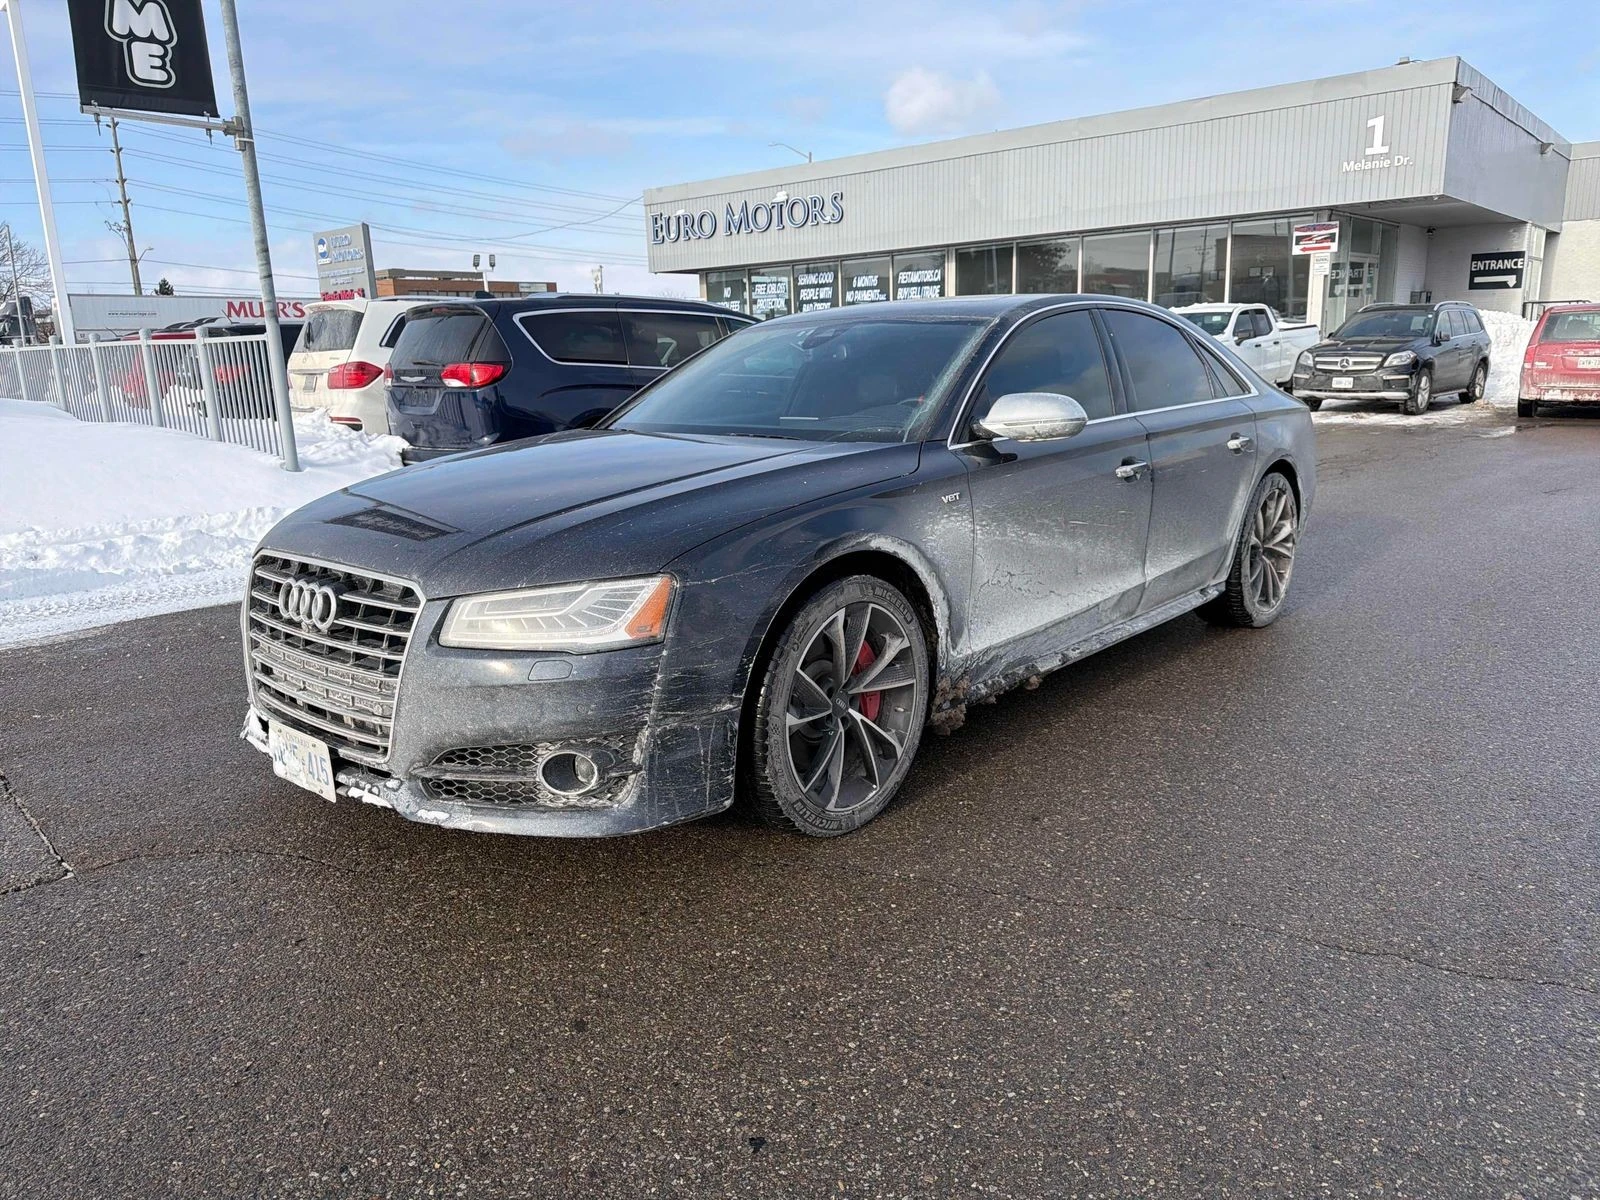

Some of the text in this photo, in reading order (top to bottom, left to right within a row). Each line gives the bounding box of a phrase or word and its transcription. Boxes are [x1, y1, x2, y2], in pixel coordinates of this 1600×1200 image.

[1364, 114, 1389, 155] 1
[1342, 155, 1413, 173] Melanie Dr.
[650, 191, 844, 245] EURO MOTORS
[1471, 258, 1524, 271] ENTRANCE
[798, 271, 835, 286] SERVING GOOD
[852, 275, 878, 288] 6 MONTHS
[723, 287, 732, 299] NO
[755, 283, 767, 294] FREE
[800, 287, 833, 301] PEOPLE WITH
[846, 290, 854, 303] NO
[854, 289, 880, 302] PAYMENTS
[227, 301, 306, 318] MUR'S
